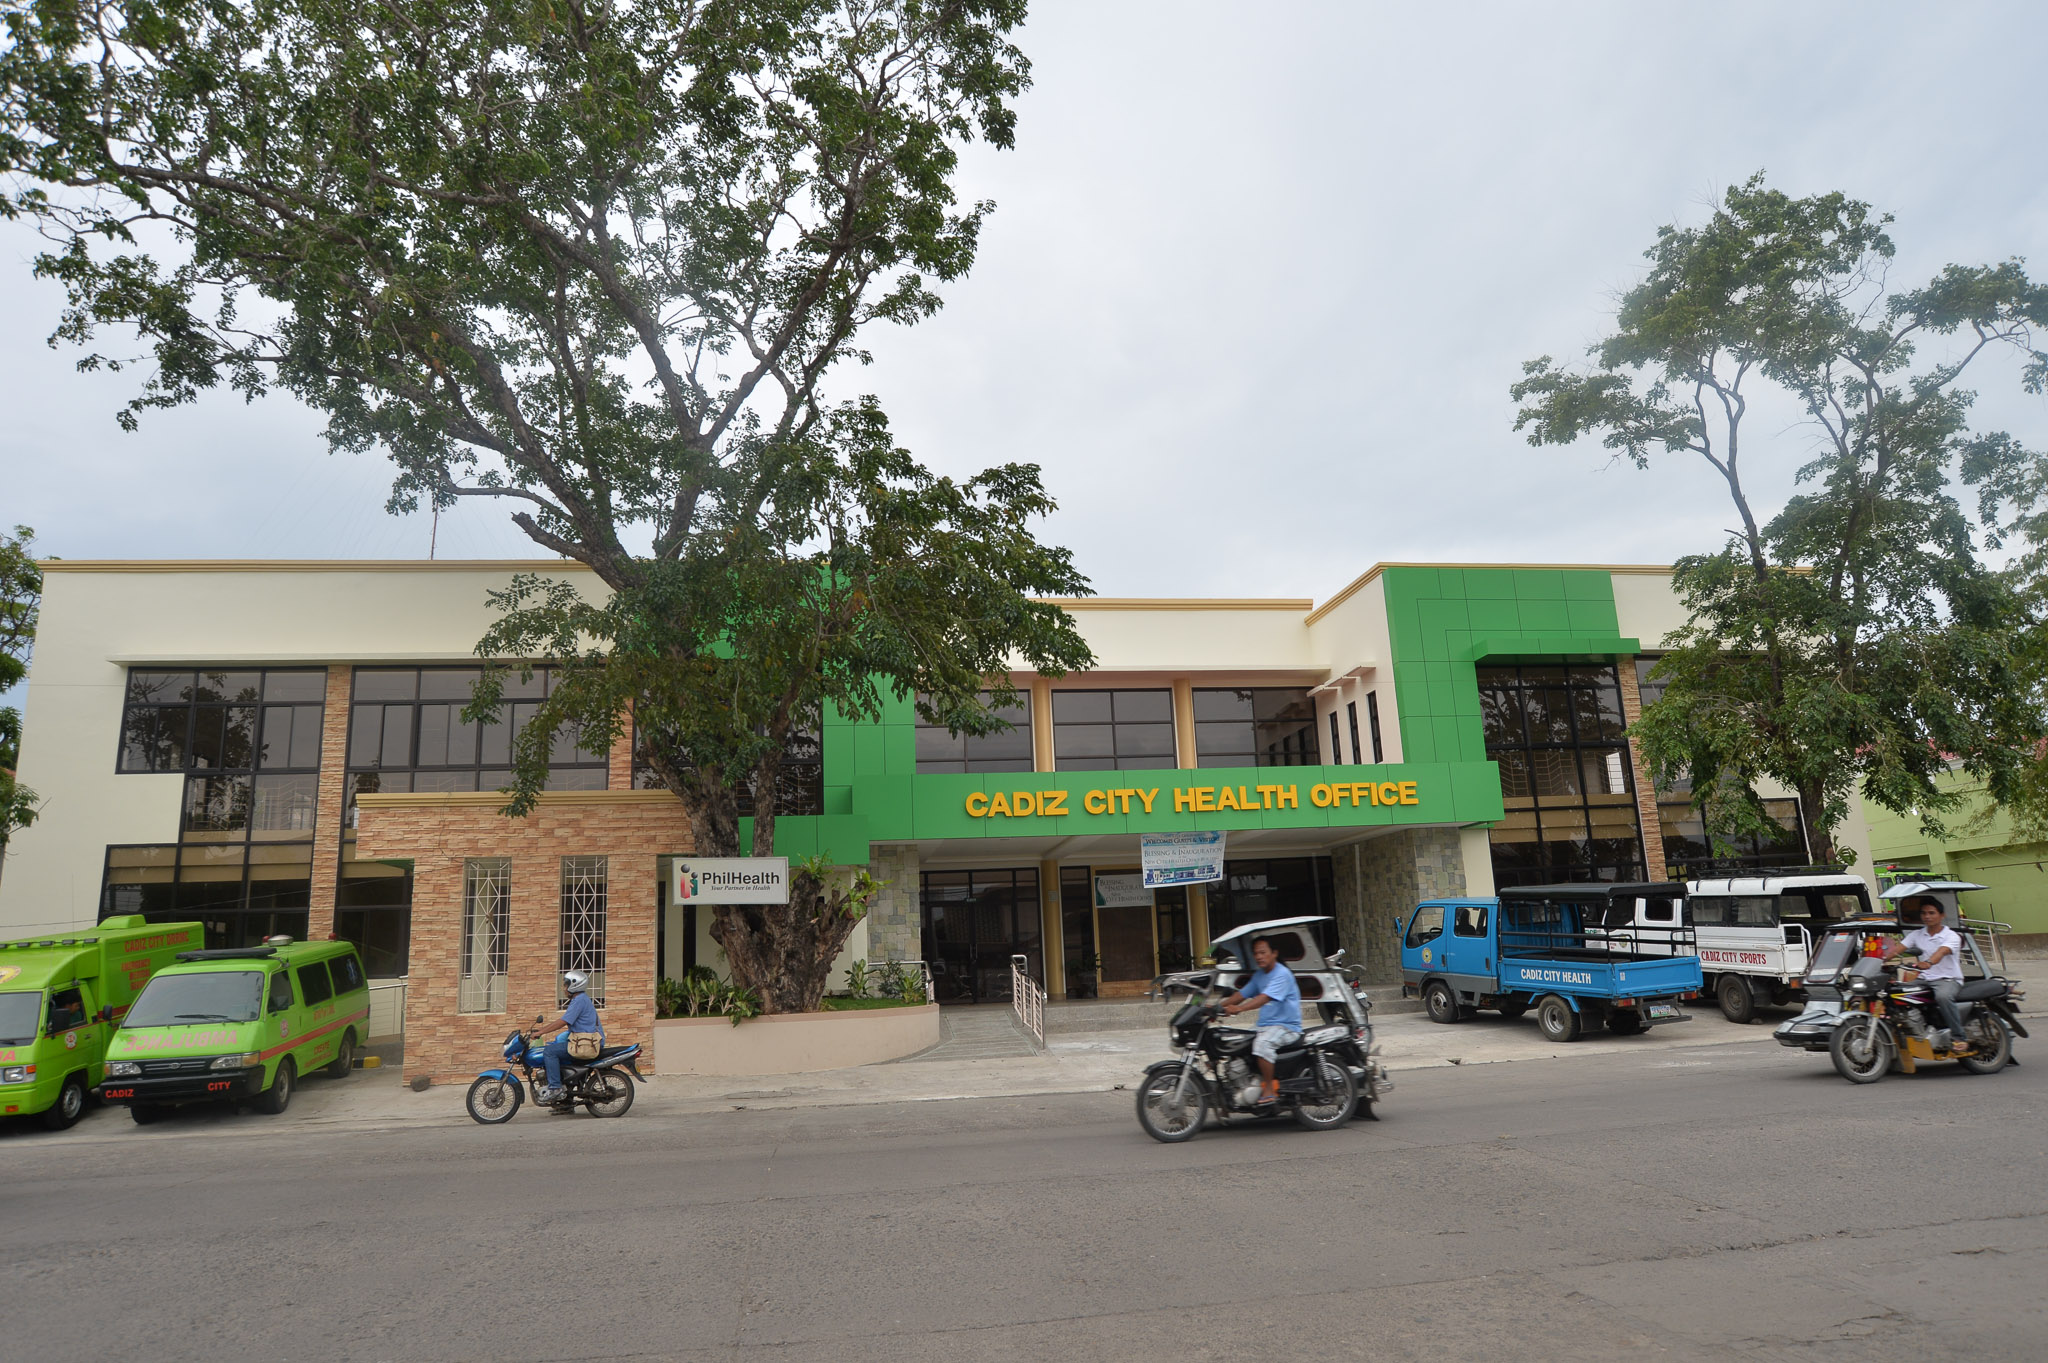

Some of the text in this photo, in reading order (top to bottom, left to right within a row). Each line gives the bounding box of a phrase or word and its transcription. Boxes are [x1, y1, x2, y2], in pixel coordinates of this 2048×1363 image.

[965, 781, 1420, 818] CADIZ CITY HEALTH OFFICE
[1144, 849, 1171, 858] BLESSING
[1178, 847, 1222, 856] INAUGURATION
[702, 872, 780, 885] PhilHealth
[1099, 879, 1124, 887] BLESSING
[124, 936, 147, 952] CADIZ
[148, 934, 164, 949] CITY
[1701, 950, 1767, 965] CADIZ CITY SPORTS
[1520, 968, 1592, 984] CADIZ CITY HEALTH
[105, 1081, 232, 1098] CADIZ CITY
